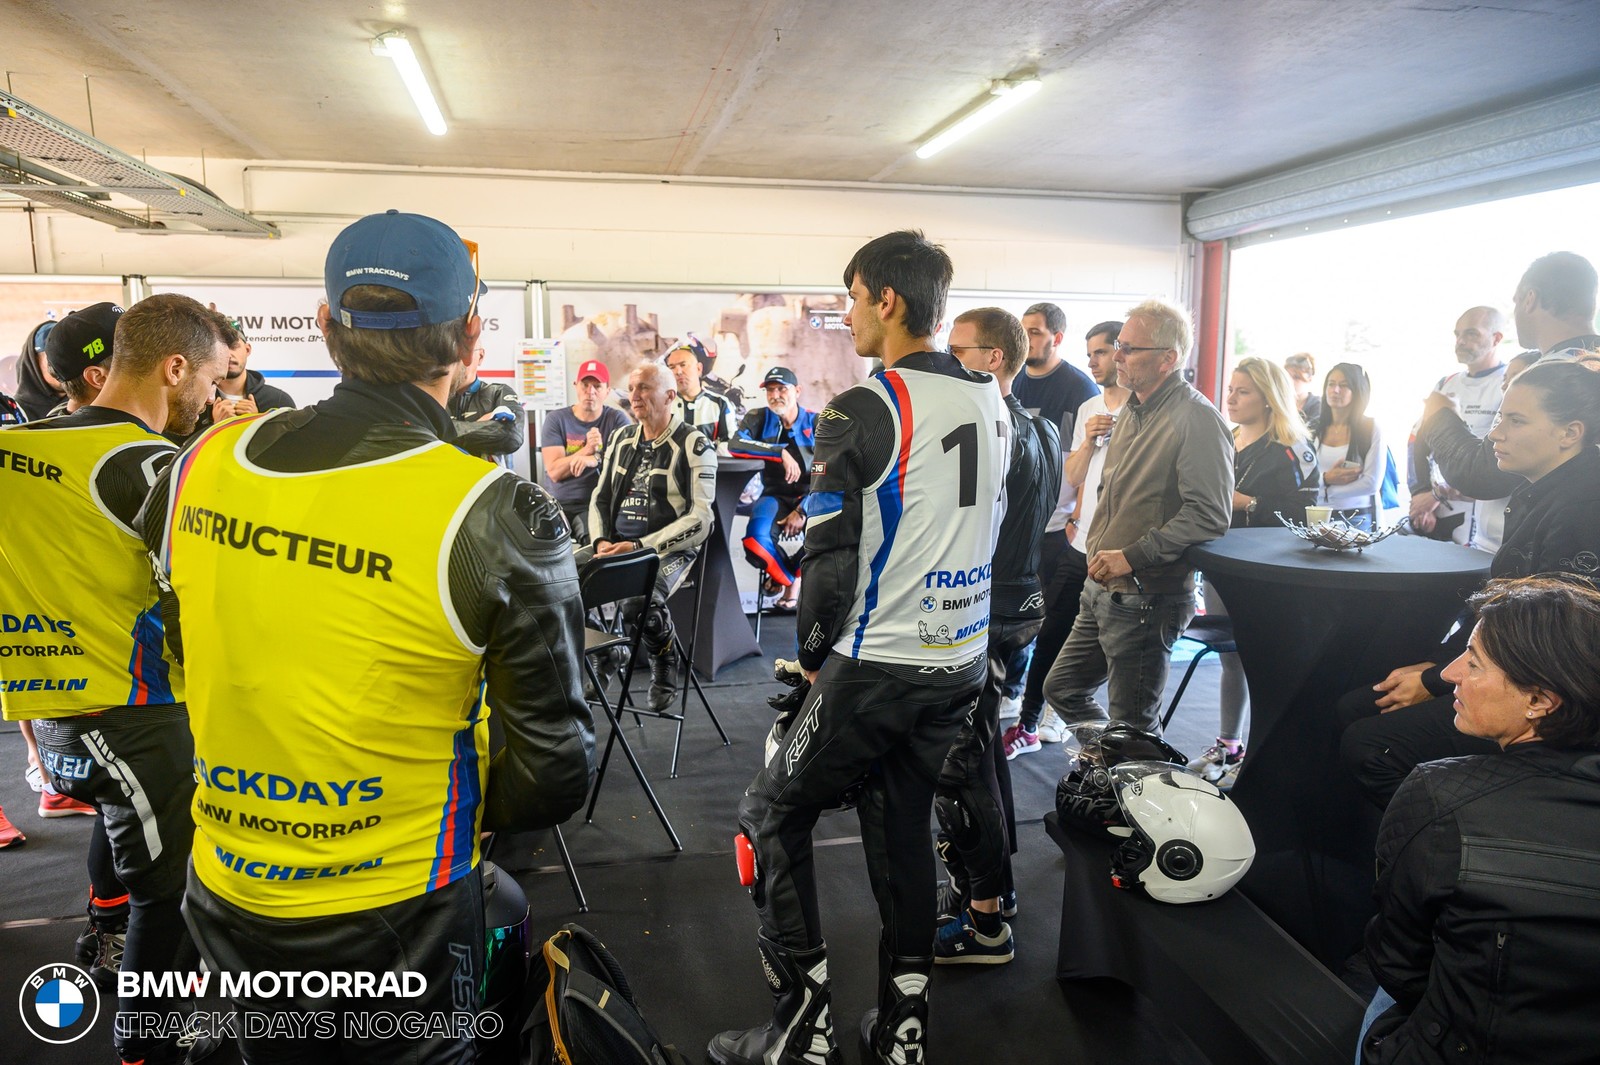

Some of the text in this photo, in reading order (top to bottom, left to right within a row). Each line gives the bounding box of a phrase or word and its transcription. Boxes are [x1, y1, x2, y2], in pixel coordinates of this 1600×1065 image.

[345, 267, 410, 281] BMW TRACKDAYS
[271, 315, 321, 330] MOT
[82, 337, 105, 360] 78
[178, 504, 394, 583] INSTRUCTEUR
[942, 596, 972, 611] BMW
[0, 613, 76, 639] DAYS
[239, 812, 382, 839] MOTORRAD
[215, 845, 384, 881] MICHELIN
